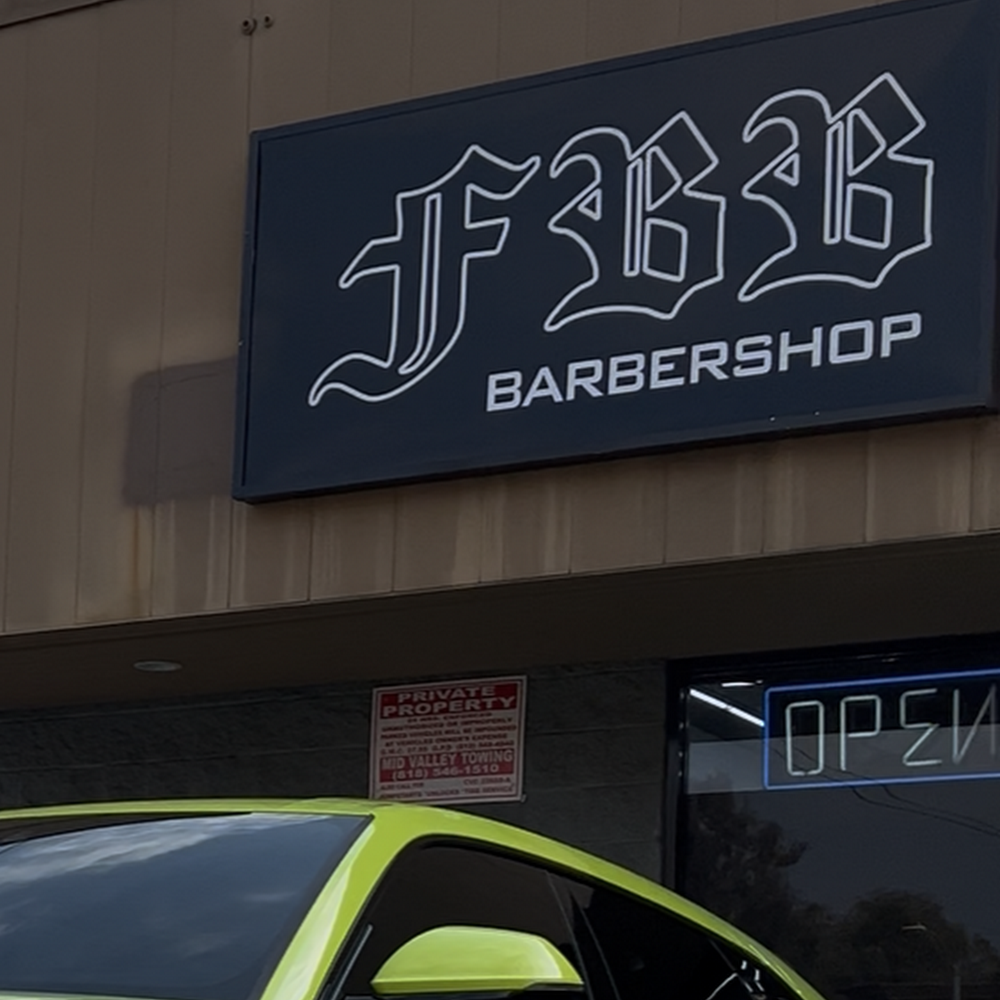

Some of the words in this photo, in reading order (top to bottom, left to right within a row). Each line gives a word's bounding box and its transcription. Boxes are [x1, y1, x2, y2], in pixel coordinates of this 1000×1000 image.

[308, 71, 935, 407] FBB
[486, 312, 923, 412] BARBERSHOP
[398, 685, 496, 703] PRIVATE
[383, 696, 515, 717] PROPERTY
[382, 757, 405, 770] MID
[409, 752, 458, 767] VALLEY
[461, 749, 513, 764] TOWING
